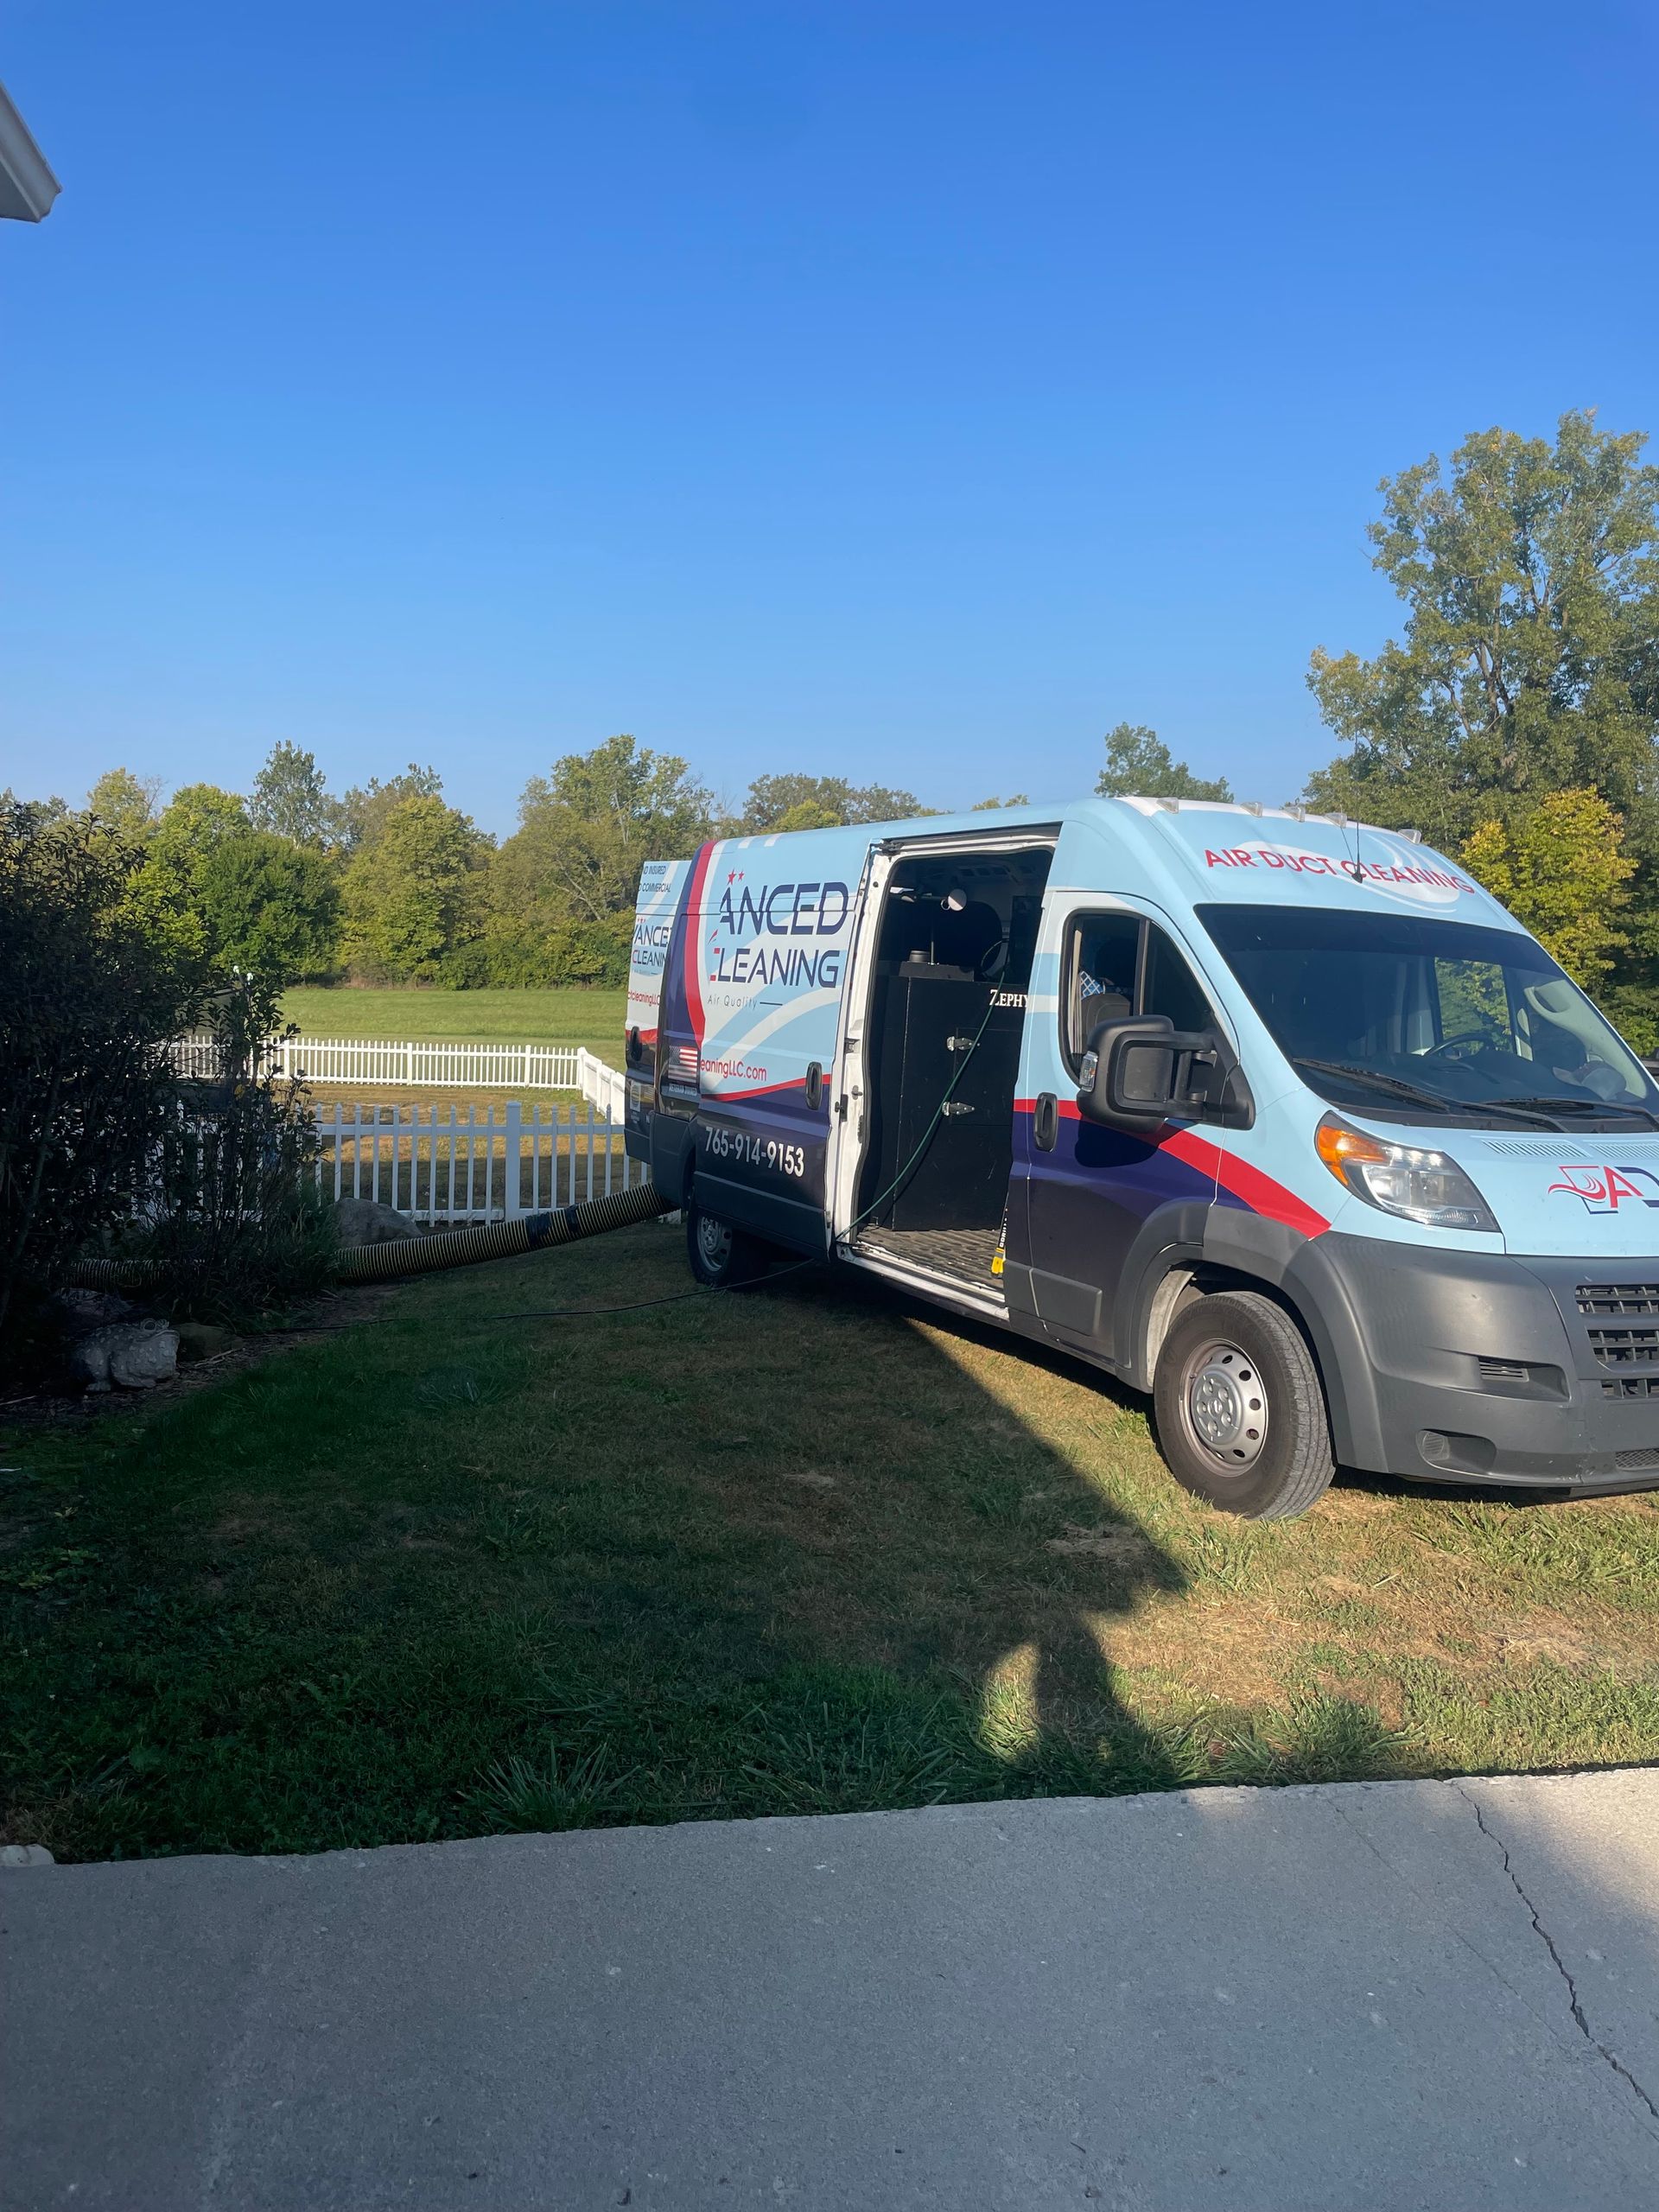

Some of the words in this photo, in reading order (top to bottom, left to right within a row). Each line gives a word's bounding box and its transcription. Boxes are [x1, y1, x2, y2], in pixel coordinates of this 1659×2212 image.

[1205, 849, 1257, 868] AIR
[1256, 849, 1339, 875] DUCT
[1340, 860, 1476, 894] CLEANING
[719, 881, 849, 936] ANCED
[709, 947, 840, 988] LEANING
[708, 995, 720, 1004] Air
[724, 995, 758, 1009] Quality
[705, 1126, 804, 1177] 765-914-9153
